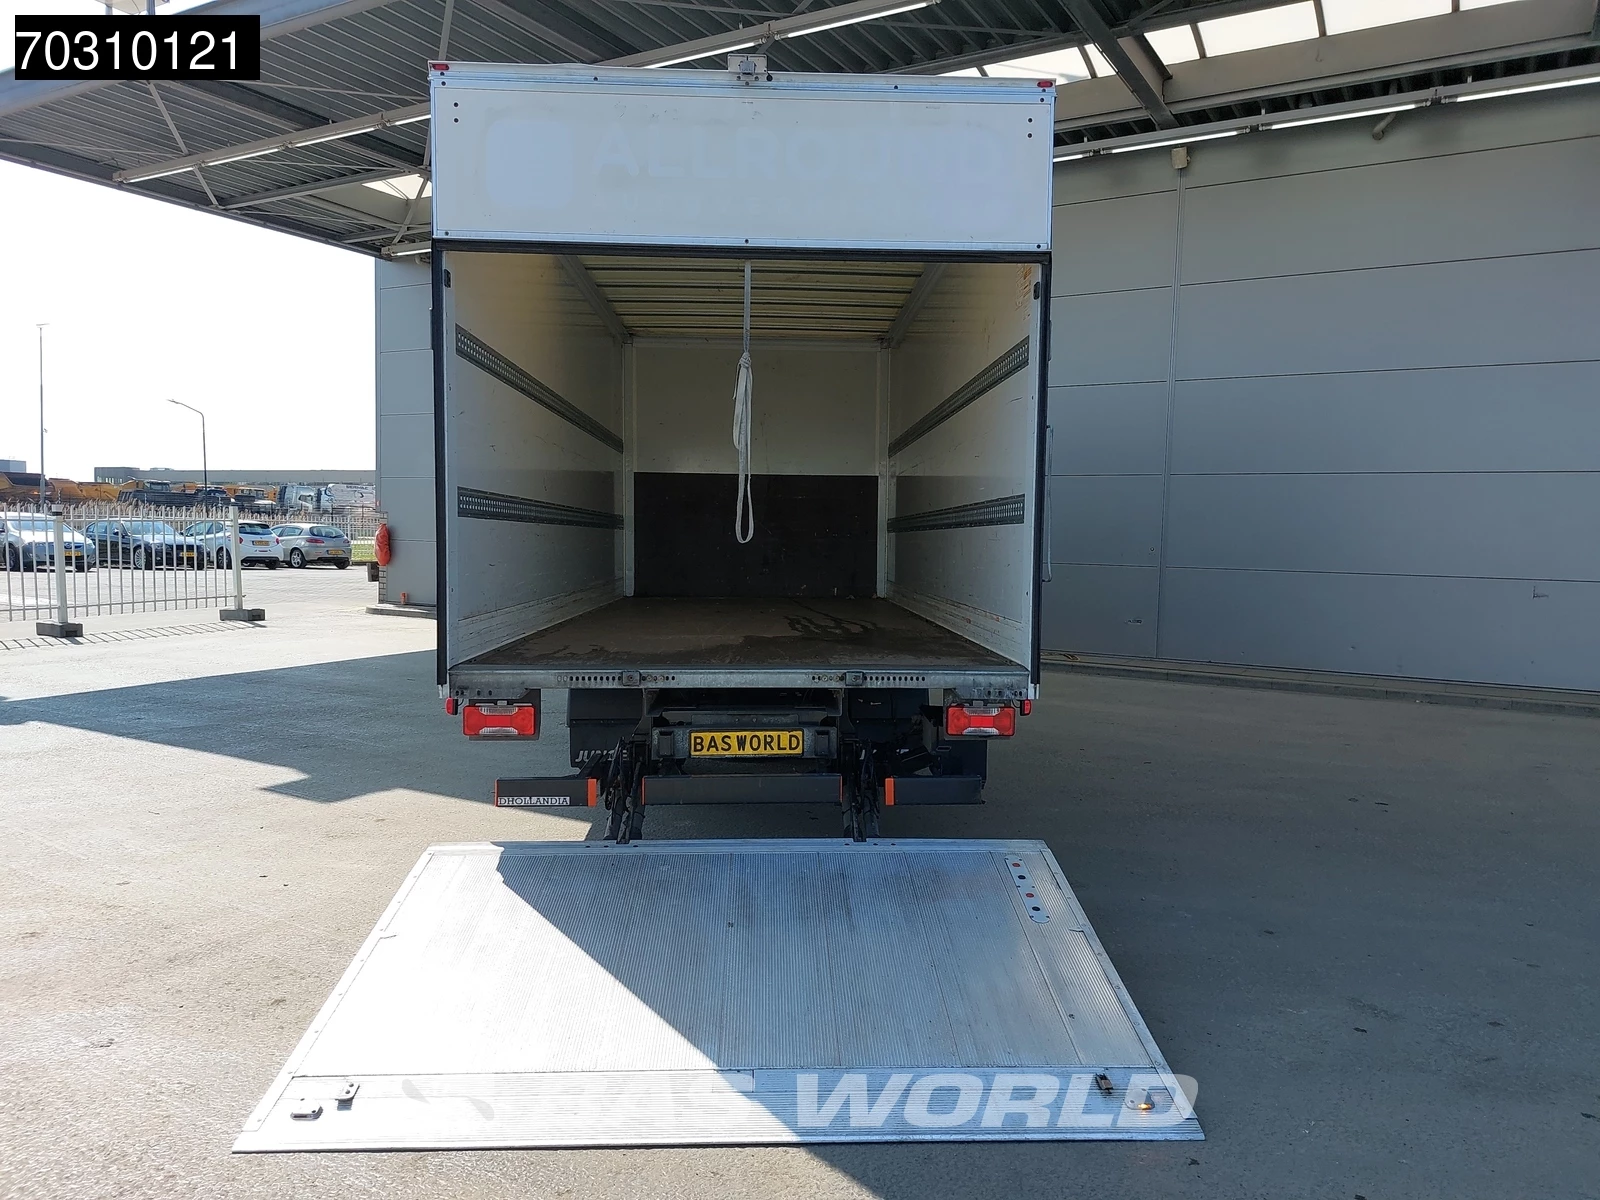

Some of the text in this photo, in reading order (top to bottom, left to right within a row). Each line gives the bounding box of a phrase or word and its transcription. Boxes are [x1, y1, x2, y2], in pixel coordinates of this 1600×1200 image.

[693, 734, 800, 752] BAS WORLD
[498, 797, 569, 805] DHOLLANDIA
